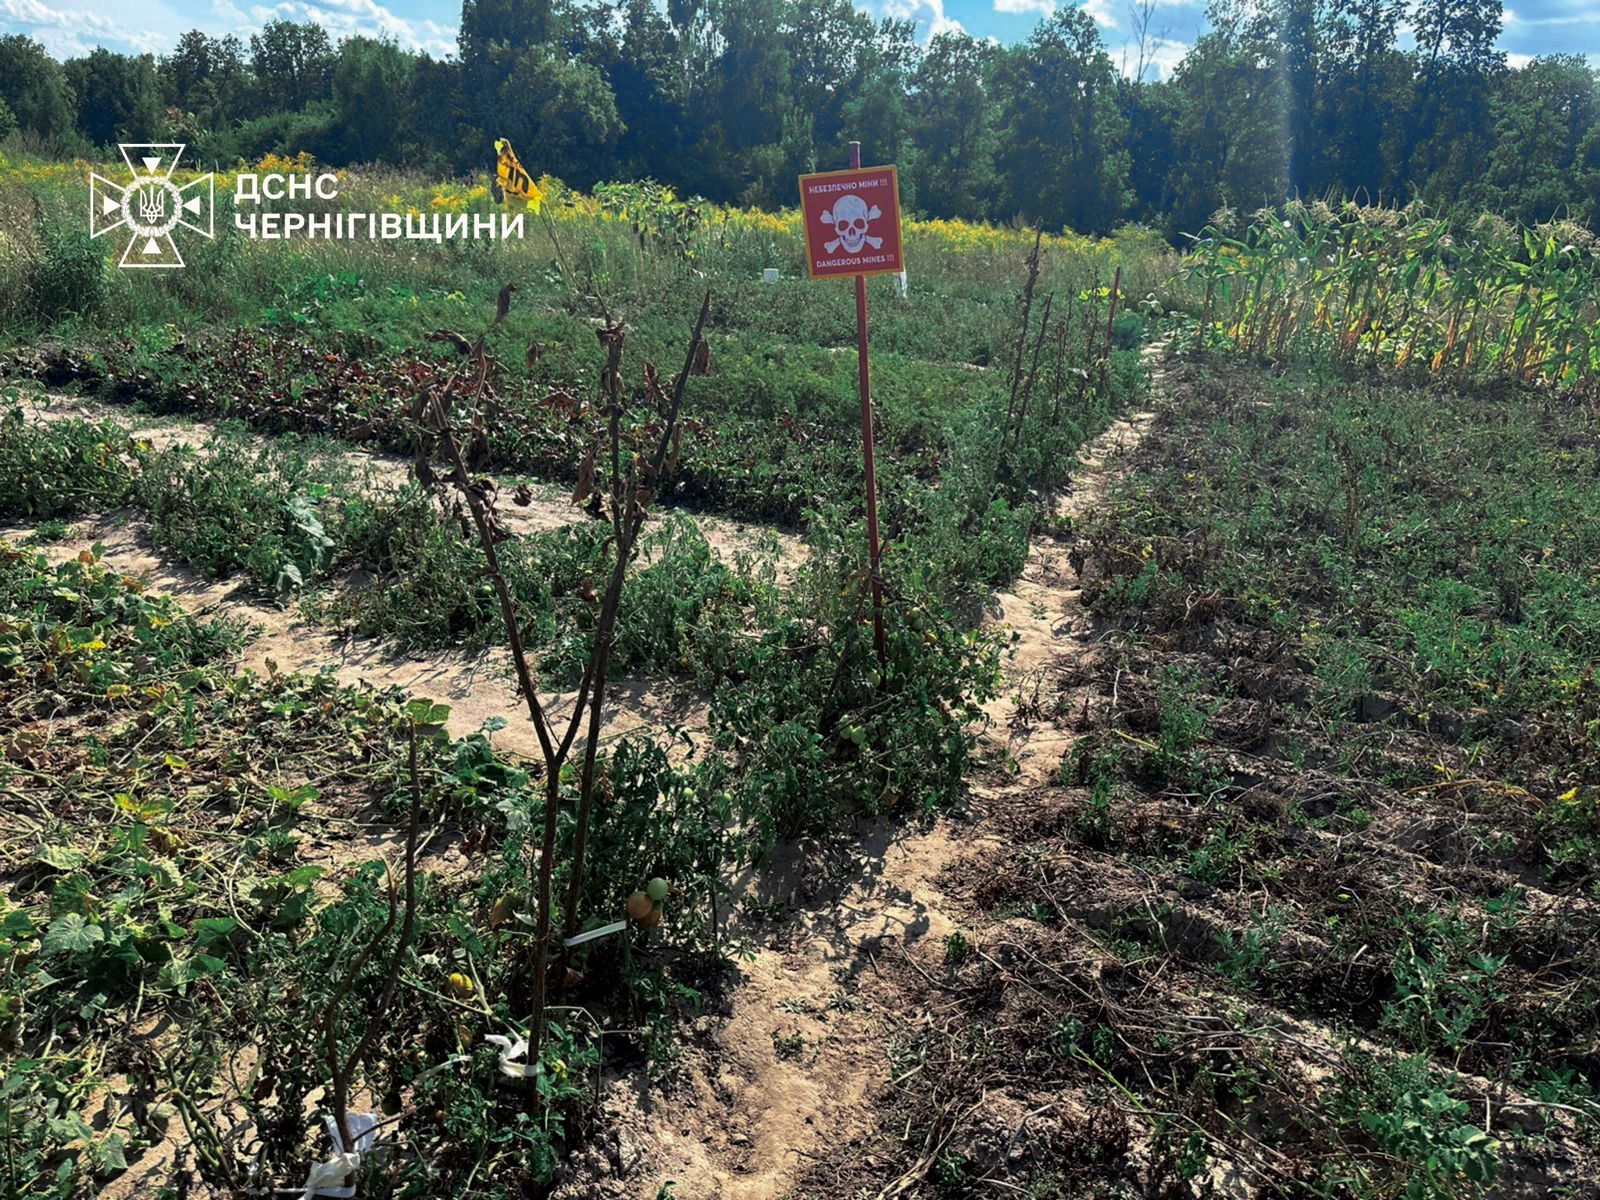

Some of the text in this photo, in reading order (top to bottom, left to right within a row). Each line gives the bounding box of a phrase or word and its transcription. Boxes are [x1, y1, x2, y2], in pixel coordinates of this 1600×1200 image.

[809, 182, 857, 194] НЕБЕЗПЕЧНО
[859, 179, 879, 188] МІНИ
[817, 257, 861, 268] DANGEROUS
[863, 255, 885, 264] MINES
